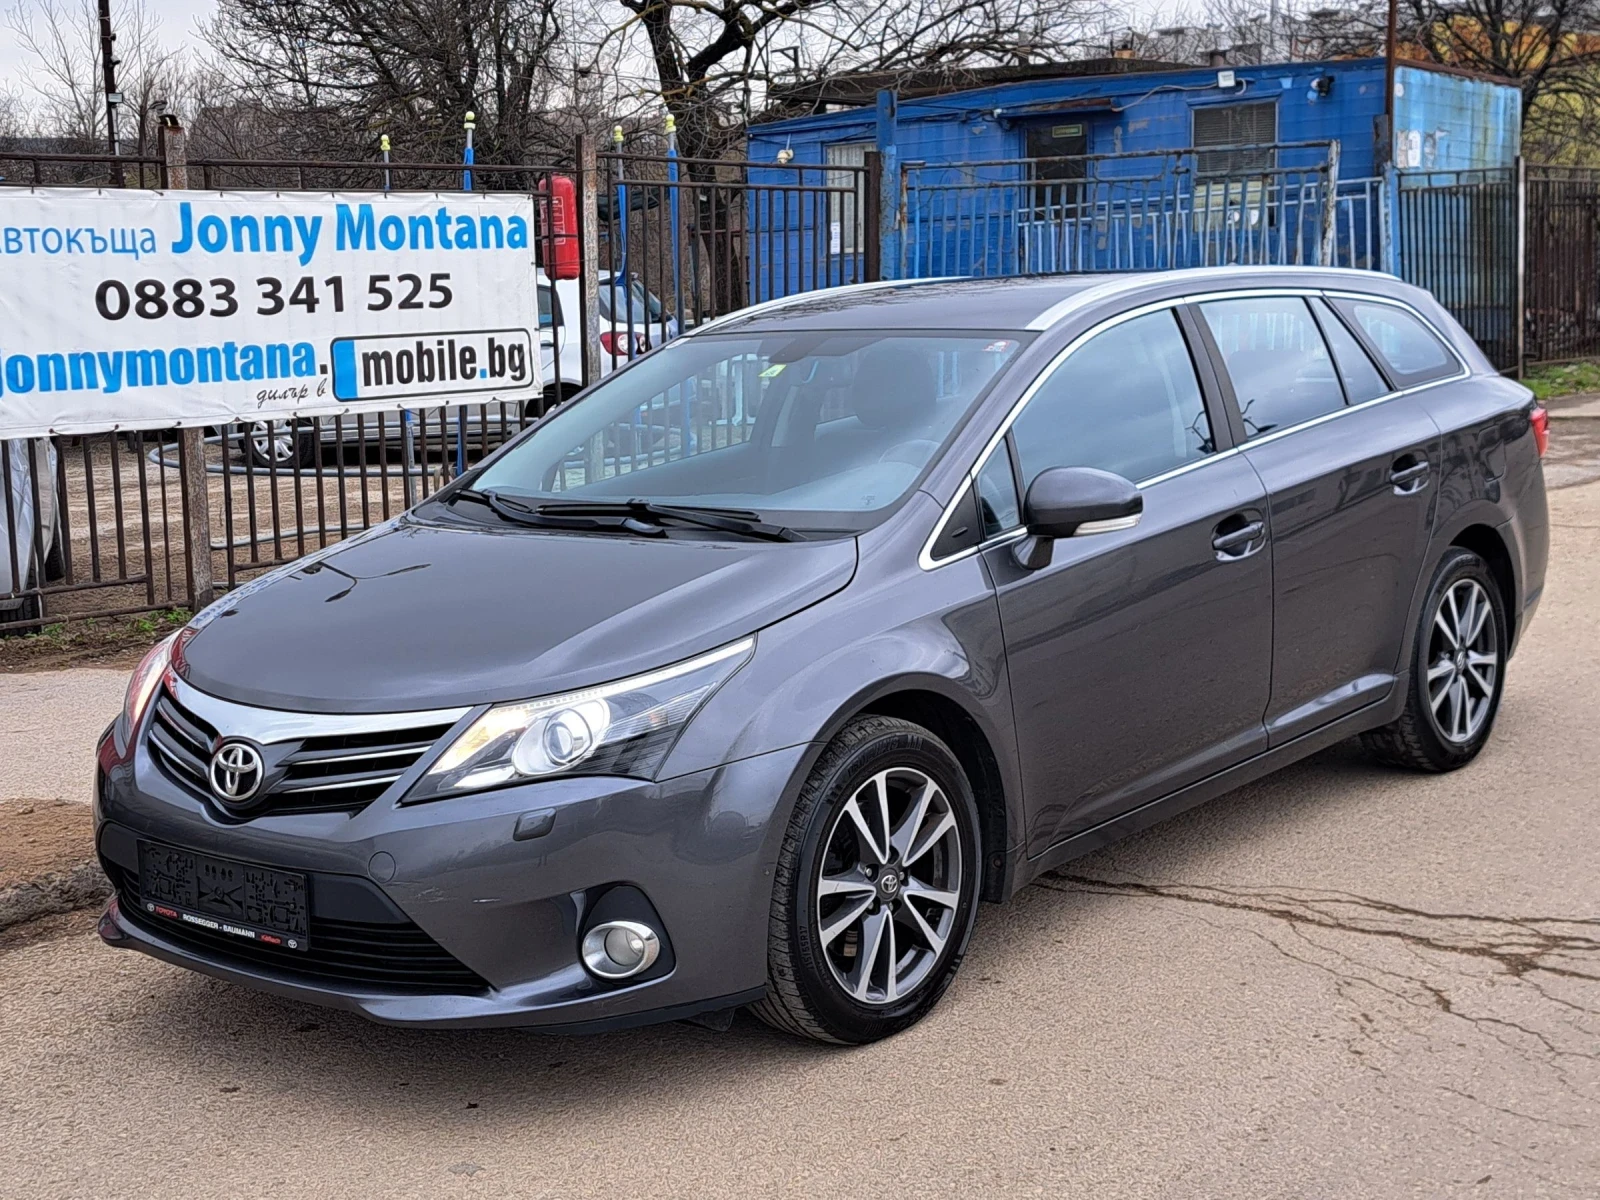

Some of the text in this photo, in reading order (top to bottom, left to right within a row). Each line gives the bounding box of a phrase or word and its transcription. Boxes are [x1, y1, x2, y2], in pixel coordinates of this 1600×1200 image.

[0, 227, 157, 260] втокъща
[171, 201, 323, 267] Jonny
[335, 203, 528, 252] Montana
[95, 272, 453, 321] 0883 341 525
[0, 337, 526, 398] onnymontana. mobile.bg
[223, 924, 256, 939] BAUMANN
